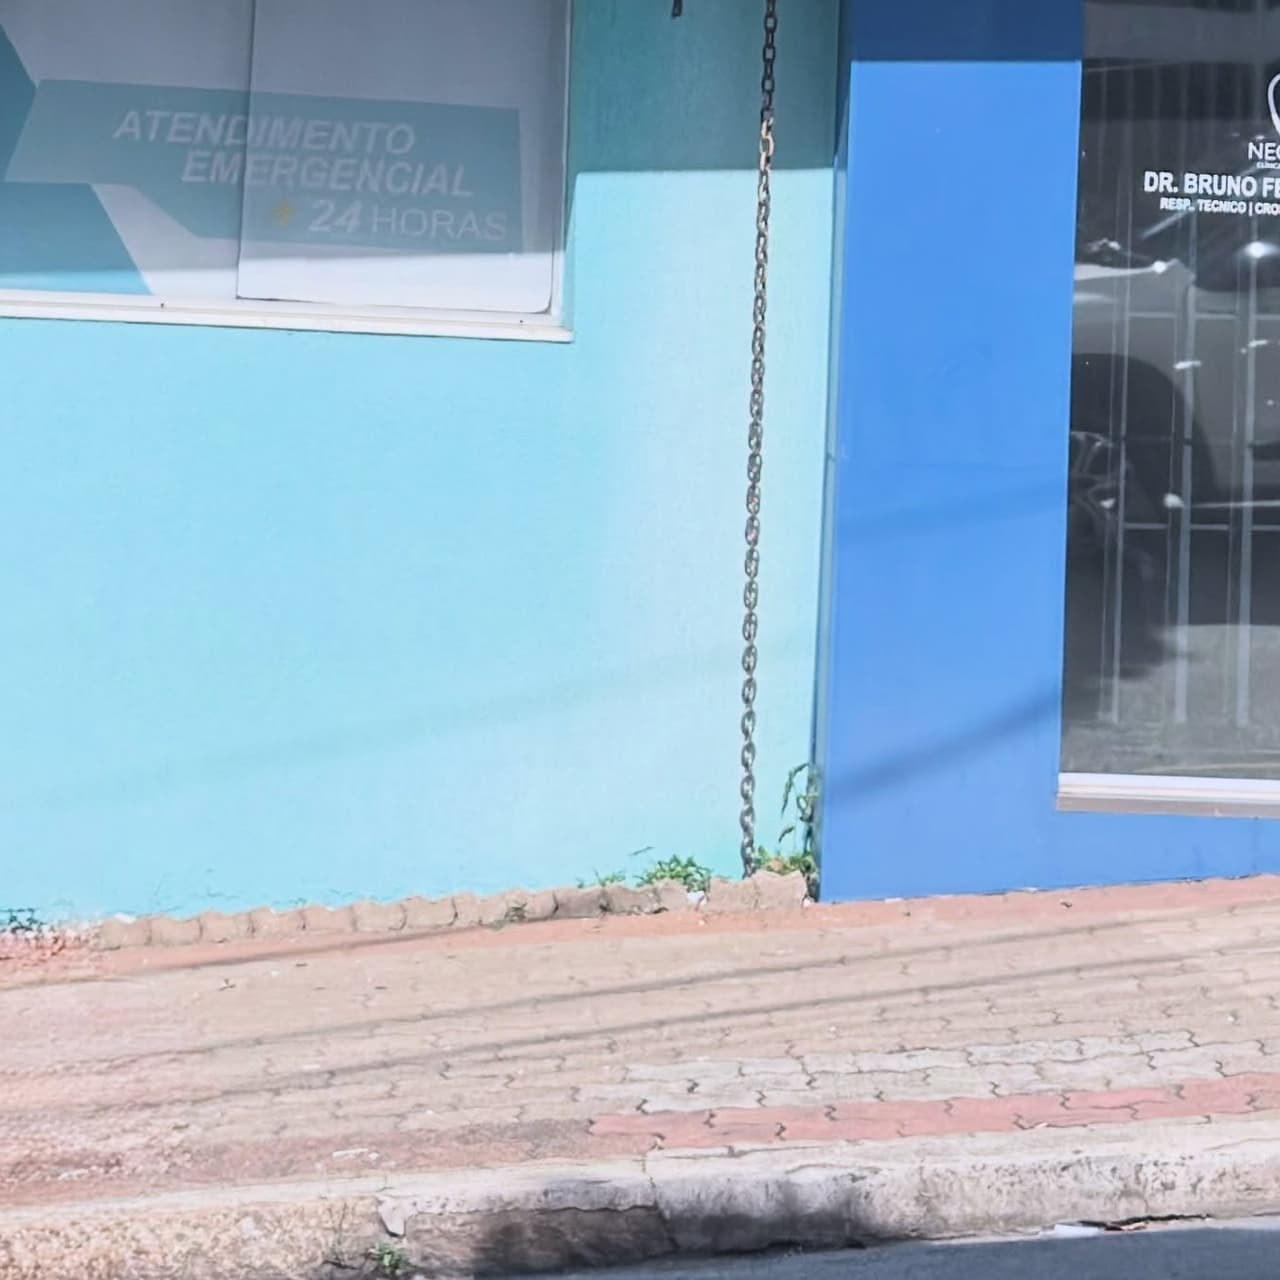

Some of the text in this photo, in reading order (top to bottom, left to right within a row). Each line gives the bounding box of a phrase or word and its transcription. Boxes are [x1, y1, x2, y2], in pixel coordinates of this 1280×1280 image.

[111, 109, 417, 155] ATENDIMENTO
[180, 149, 476, 198] EMERGENCIAL
[1143, 171, 1179, 193] DR.
[1183, 172, 1257, 197] BRUNO
[308, 198, 507, 241] 24 HORAS
